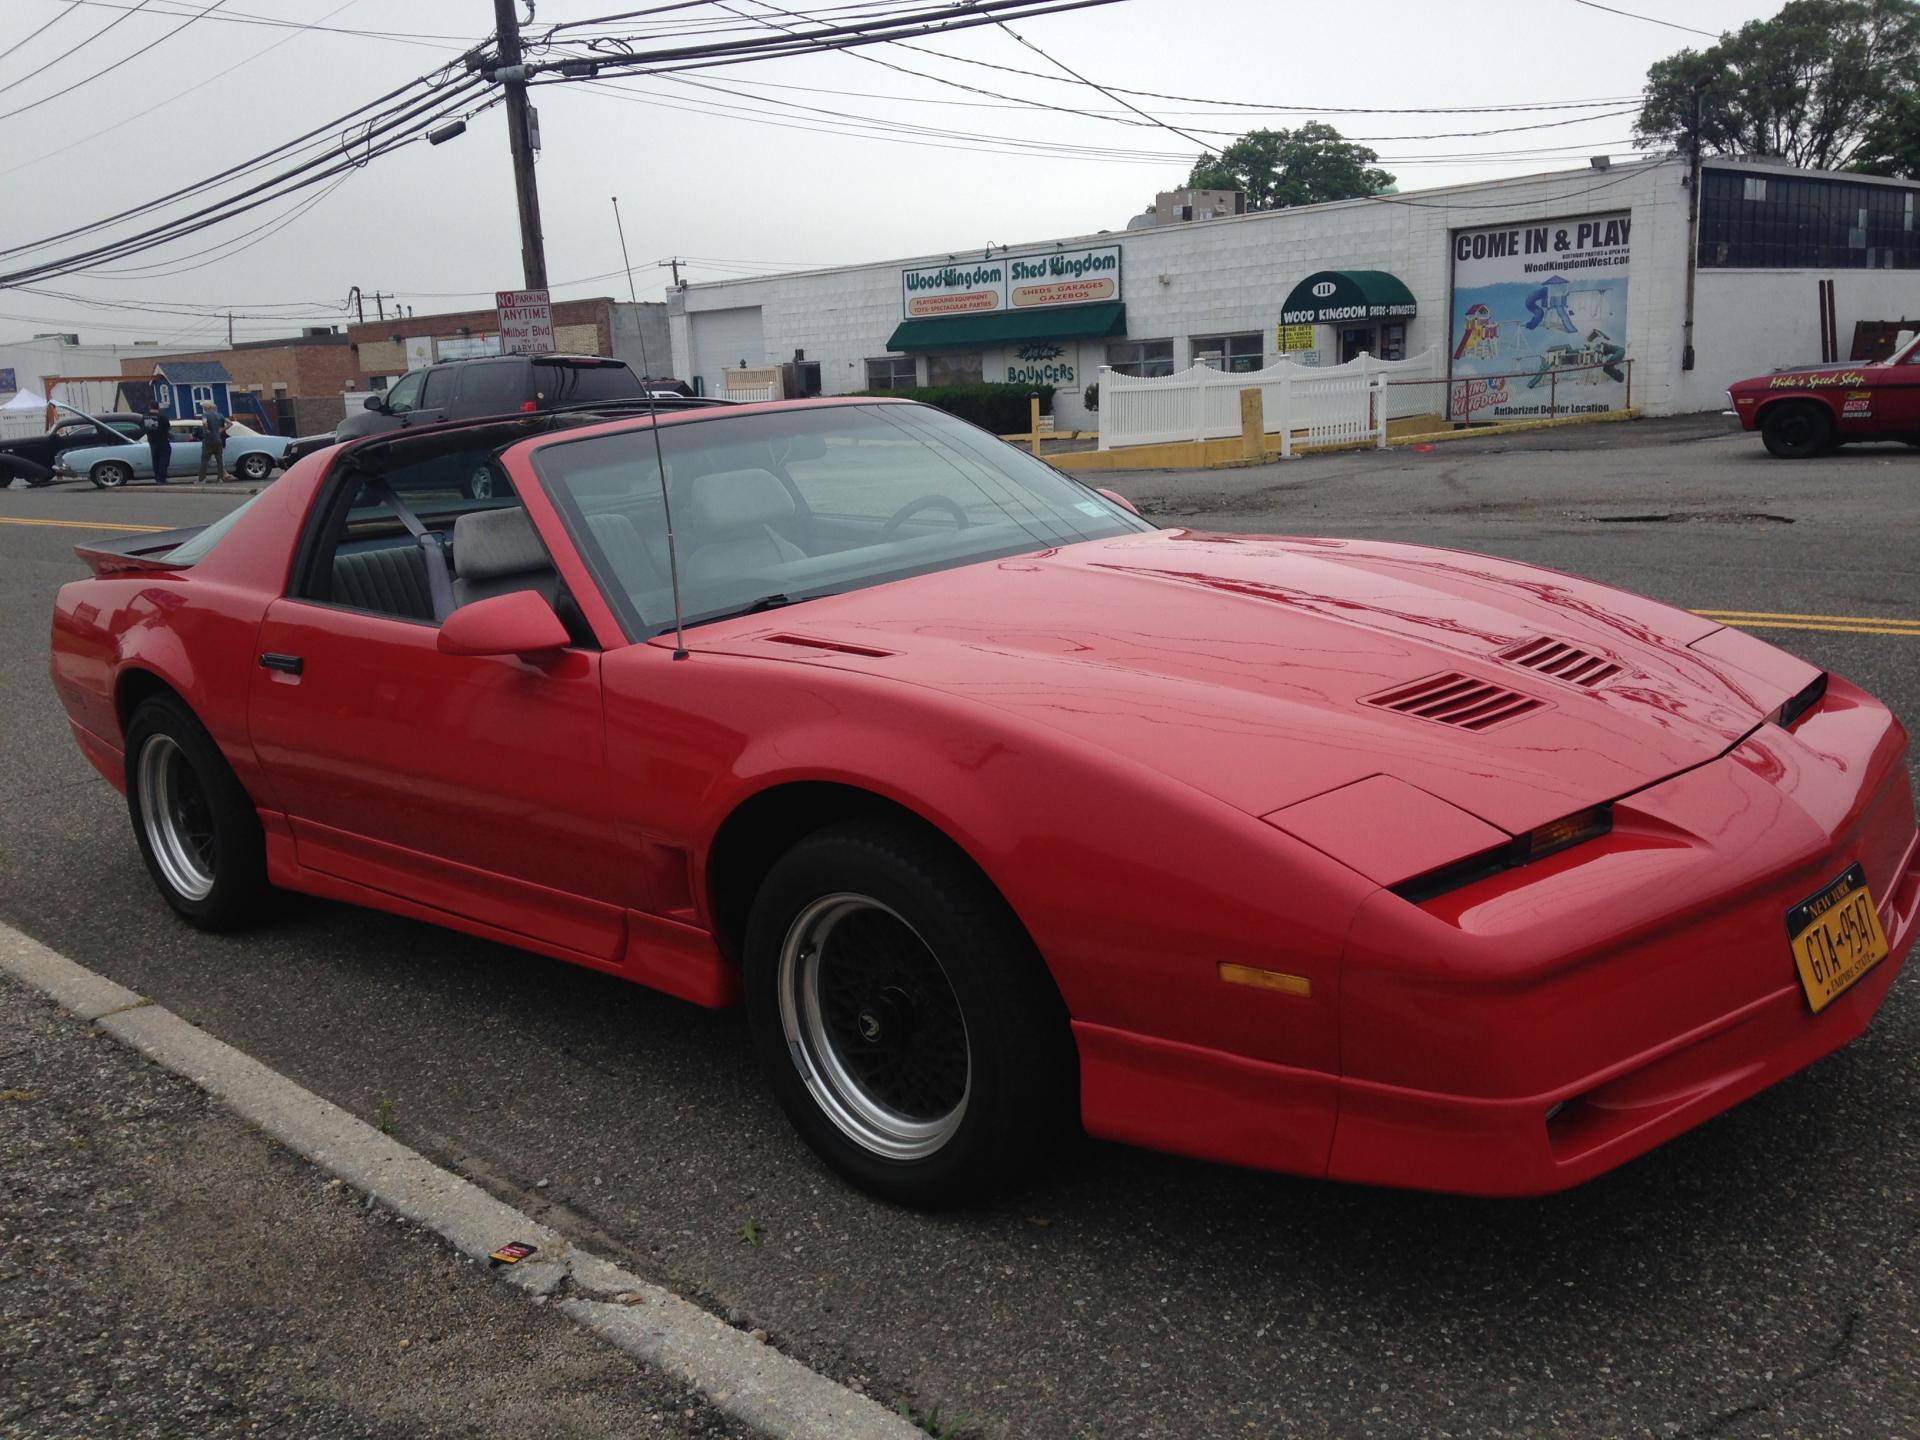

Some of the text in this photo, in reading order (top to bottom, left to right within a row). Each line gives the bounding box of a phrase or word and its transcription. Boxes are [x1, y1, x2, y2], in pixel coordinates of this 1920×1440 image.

[1457, 218, 1631, 261] COME IN & PLAY
[1012, 253, 1116, 280] Shed Kingdom
[906, 270, 943, 291] Wood
[1022, 281, 1104, 296] SHEDS GARAGES
[497, 293, 547, 307] NO PARKING
[916, 293, 988, 305] PLAYGROUND EQUIPMENT
[1039, 291, 1089, 302] GAZEBOS
[969, 300, 992, 309] PARTIES
[1369, 305, 1386, 316] SHEDS
[503, 307, 548, 320] ANYTIME
[1283, 305, 1367, 324] WOOD KINGDOM
[503, 325, 550, 338] Milbar Blvd
[511, 343, 548, 353] BABYLON
[1007, 364, 1074, 384] BOUNCERS
[1770, 371, 1865, 389] Mike's Speed Shop
[1453, 392, 1508, 416] KINGDOM
[1494, 404, 1539, 416] Authorized
[1571, 403, 1609, 413] Location
[1830, 953, 1872, 993] EMPIRE STATE
